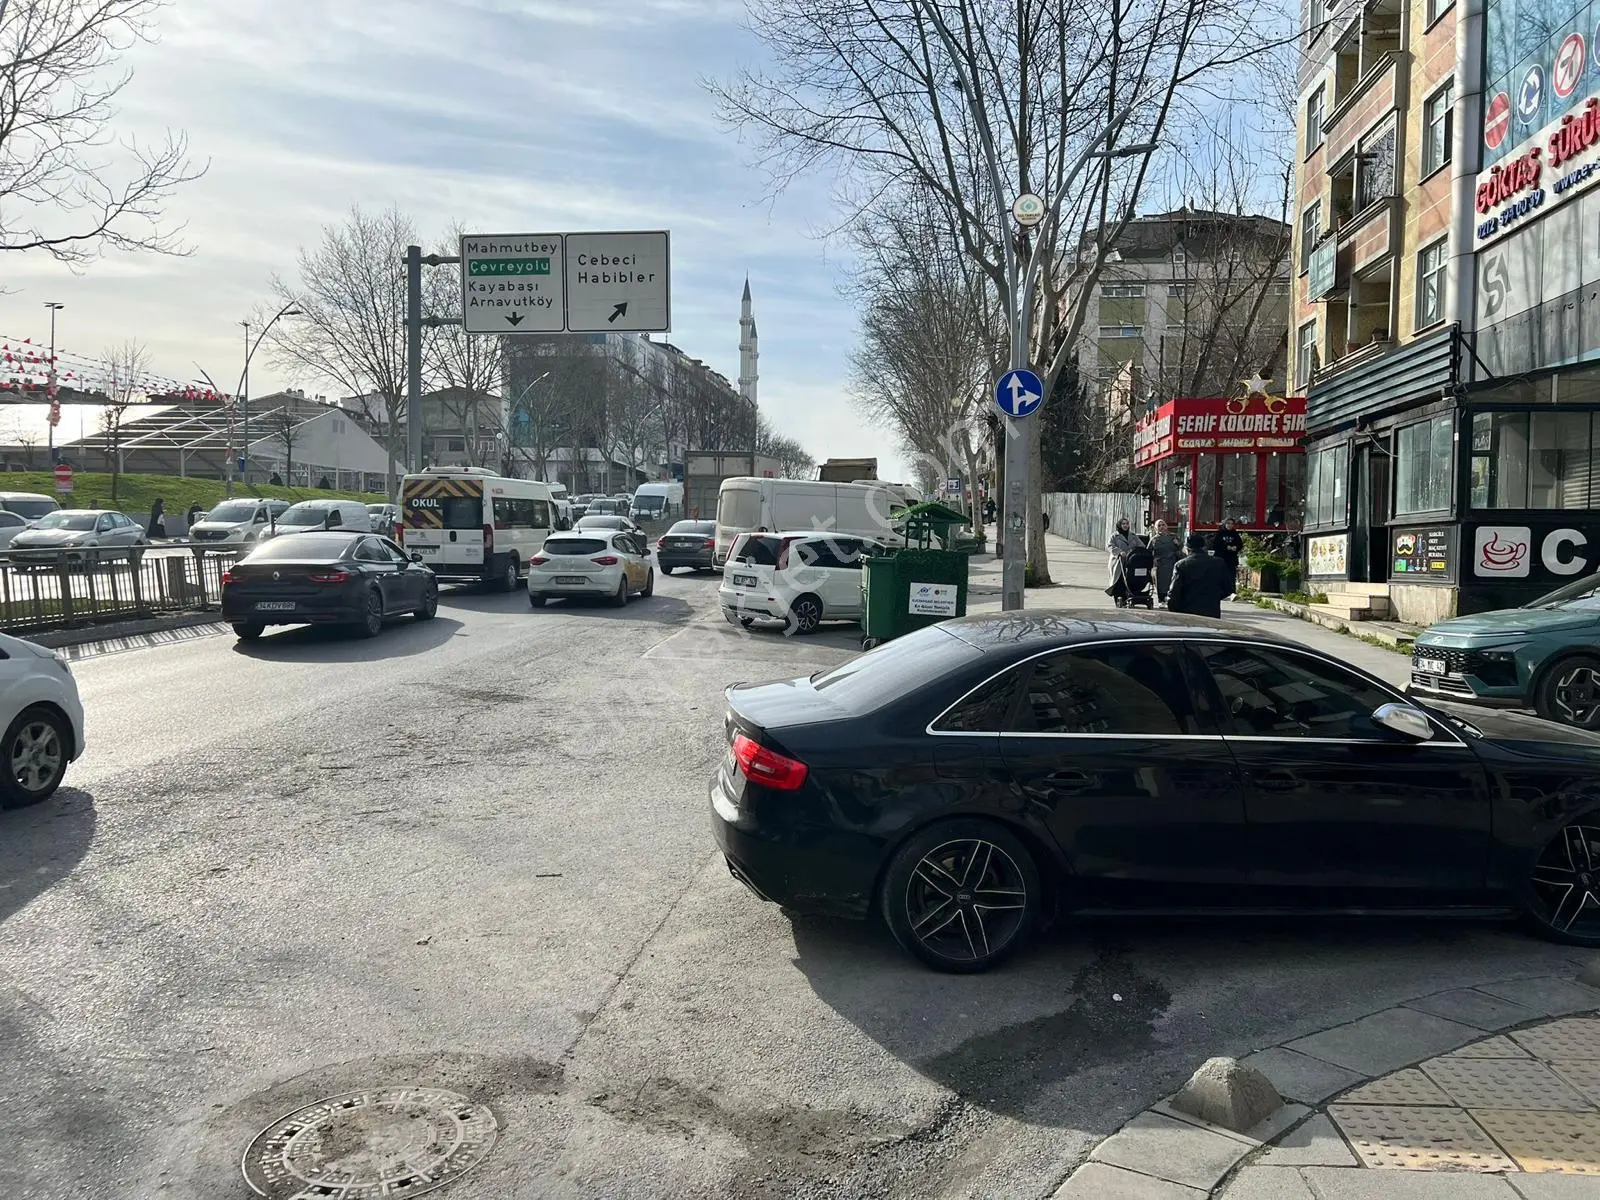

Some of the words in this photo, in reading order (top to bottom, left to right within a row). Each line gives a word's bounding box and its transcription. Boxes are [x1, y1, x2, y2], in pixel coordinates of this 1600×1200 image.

[1475, 147, 1542, 213] GÖKTAŞ
[1477, 217, 1498, 239] 0212
[1529, 188, 1544, 209] 39
[467, 242, 558, 256] Mahmutbey
[577, 253, 636, 266] Cebeci
[470, 260, 549, 275] Çevreyolu
[577, 271, 655, 284] Habibler
[468, 281, 539, 294] Kayabaşı
[469, 296, 553, 309] Arnavutköy
[1177, 413, 1217, 434] ŞERİF
[1219, 414, 1279, 434] KOKOREÇ
[412, 498, 440, 508] OKUL
